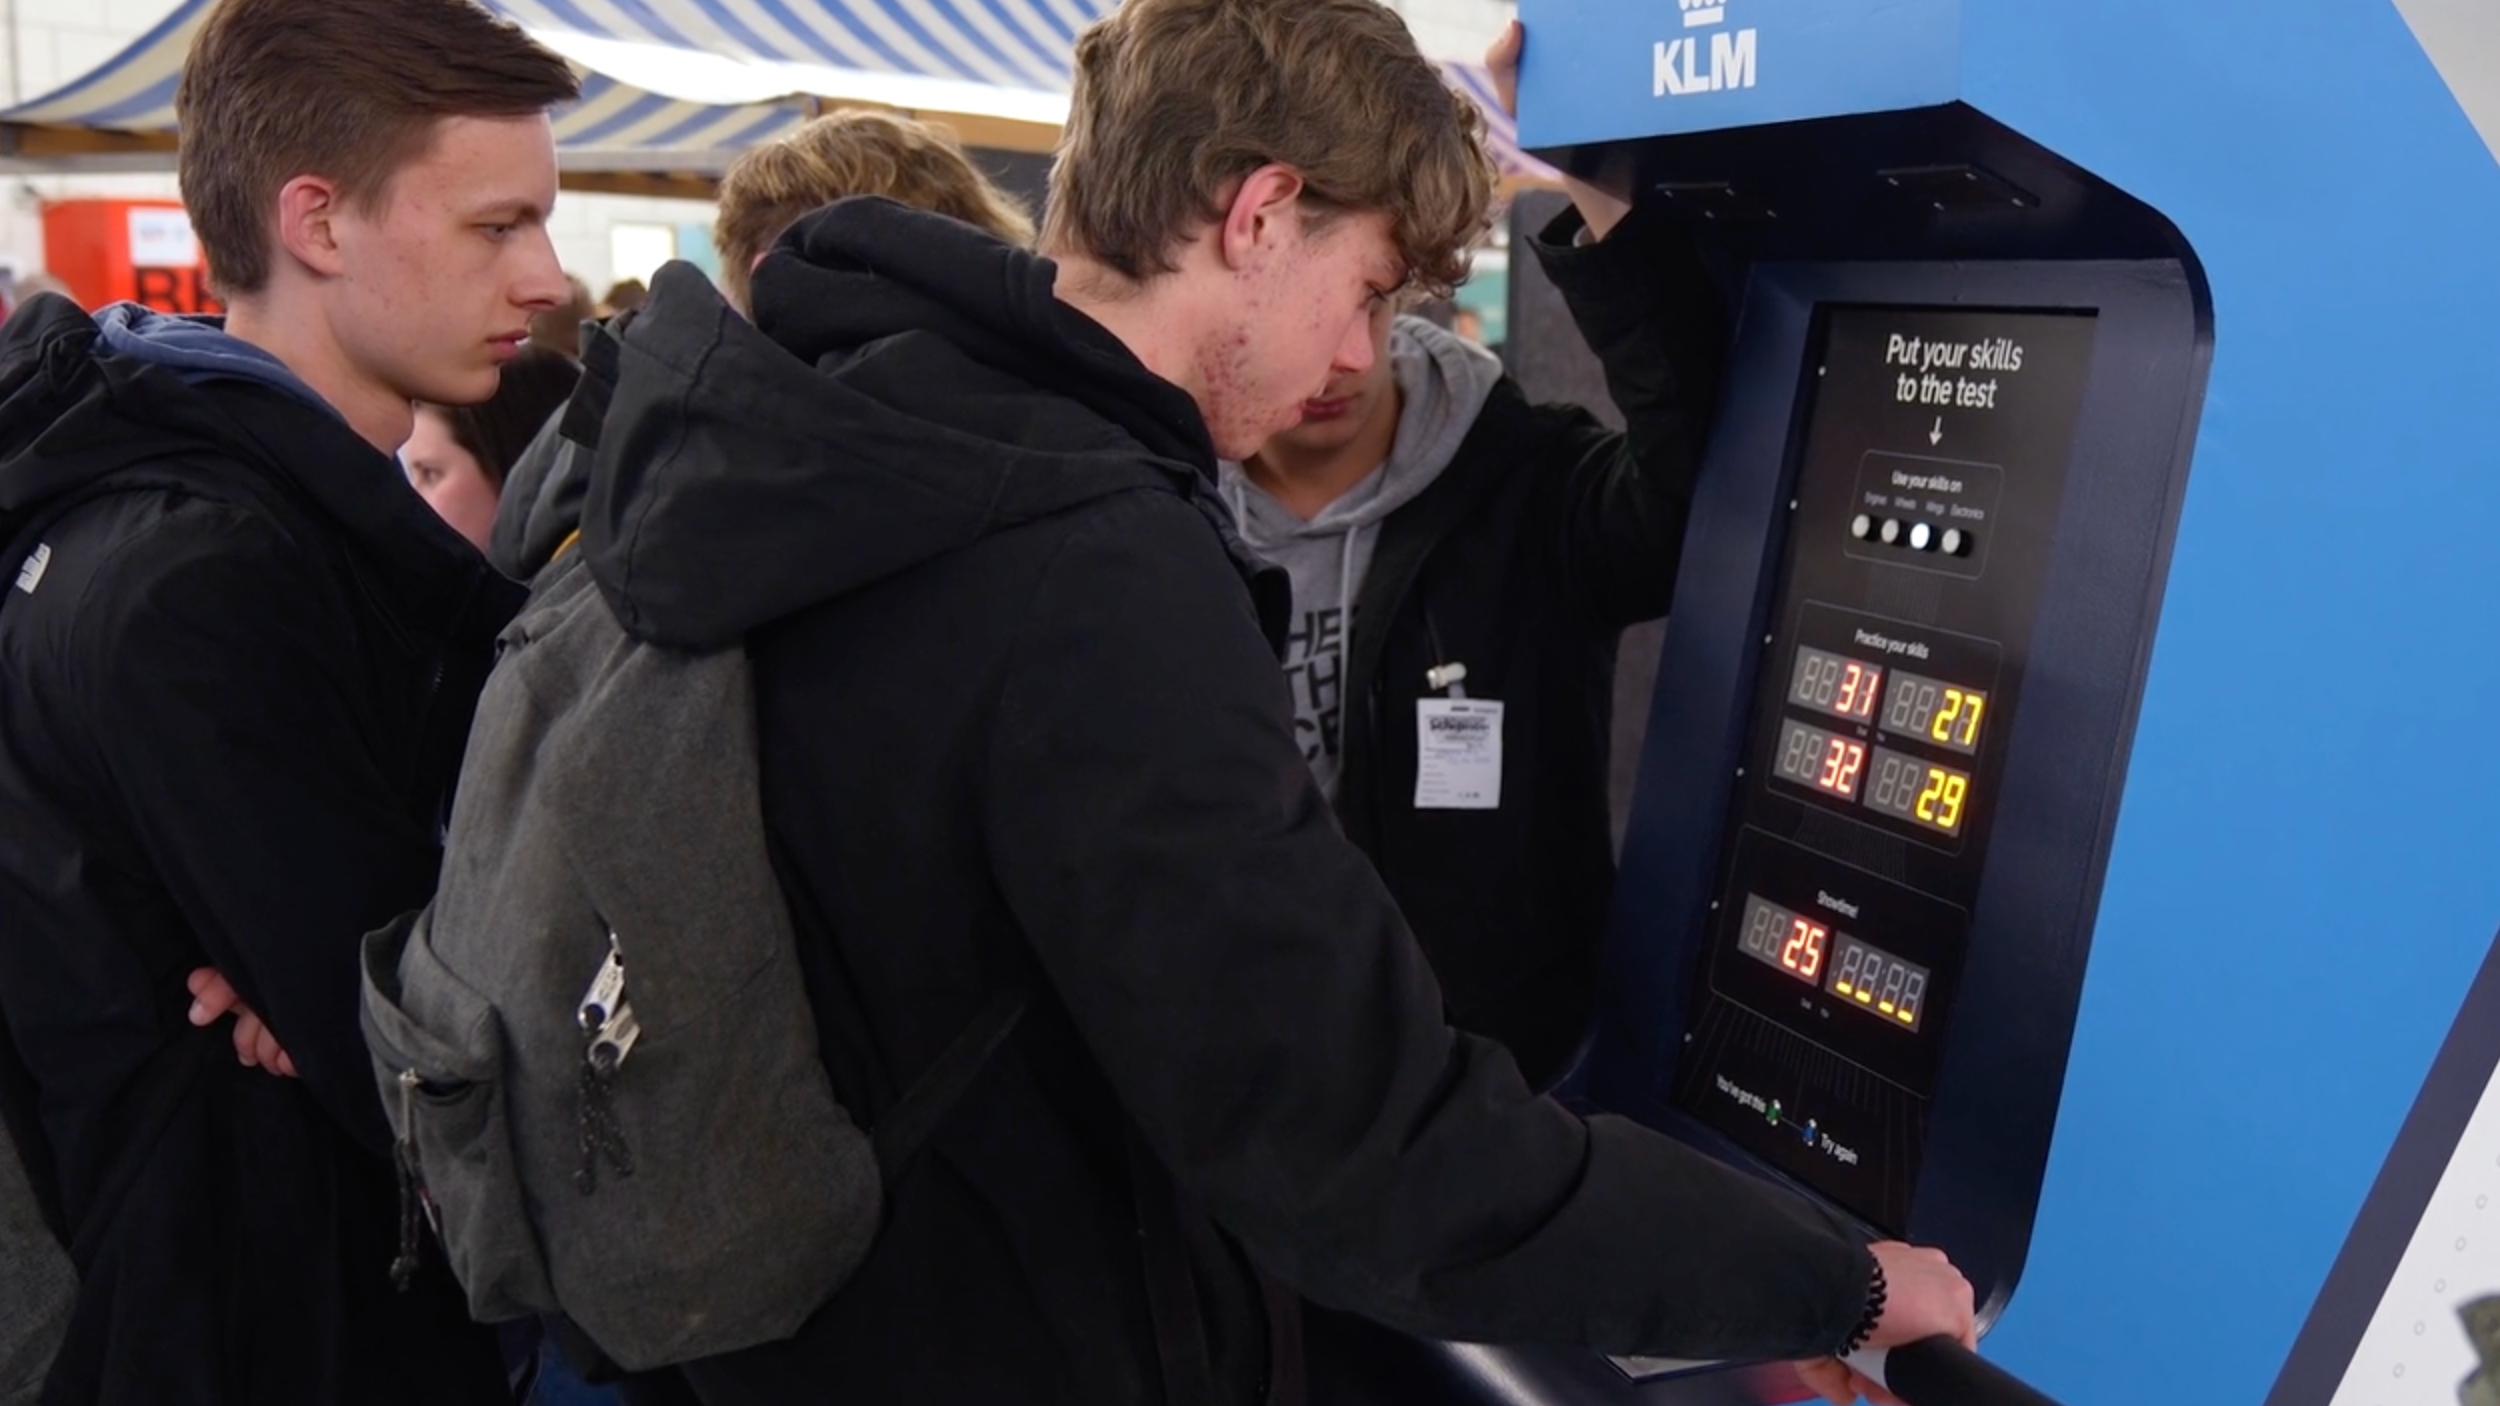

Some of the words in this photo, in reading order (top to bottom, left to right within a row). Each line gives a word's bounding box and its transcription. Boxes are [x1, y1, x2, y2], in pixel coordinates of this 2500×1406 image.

[1654, 28, 1757, 97] KLM
[1886, 333, 1921, 365] Put
[1920, 341, 1968, 373] your
[1969, 337, 2023, 371] skills
[1896, 372, 1917, 401] to
[1920, 373, 1952, 405] the
[1956, 376, 1998, 409] test
[1891, 470, 1908, 486] Use
[1907, 475, 1928, 489] your
[1928, 475, 1949, 491] skills
[1949, 480, 1962, 493] on
[1854, 628, 1887, 650] Practice
[1886, 640, 1907, 654] your
[1907, 641, 1929, 659] skills
[1835, 664, 1880, 716] 31
[1932, 689, 1983, 745] 27
[1819, 739, 1863, 793] 32
[1916, 769, 1966, 827] 29
[1816, 890, 1859, 919] Showtime!
[1783, 920, 1825, 976] 25
[1738, 1089, 1753, 1106] got
[1751, 1095, 1767, 1113] this
[1821, 1132, 1836, 1154] Try
[1833, 1143, 1858, 1165] again
